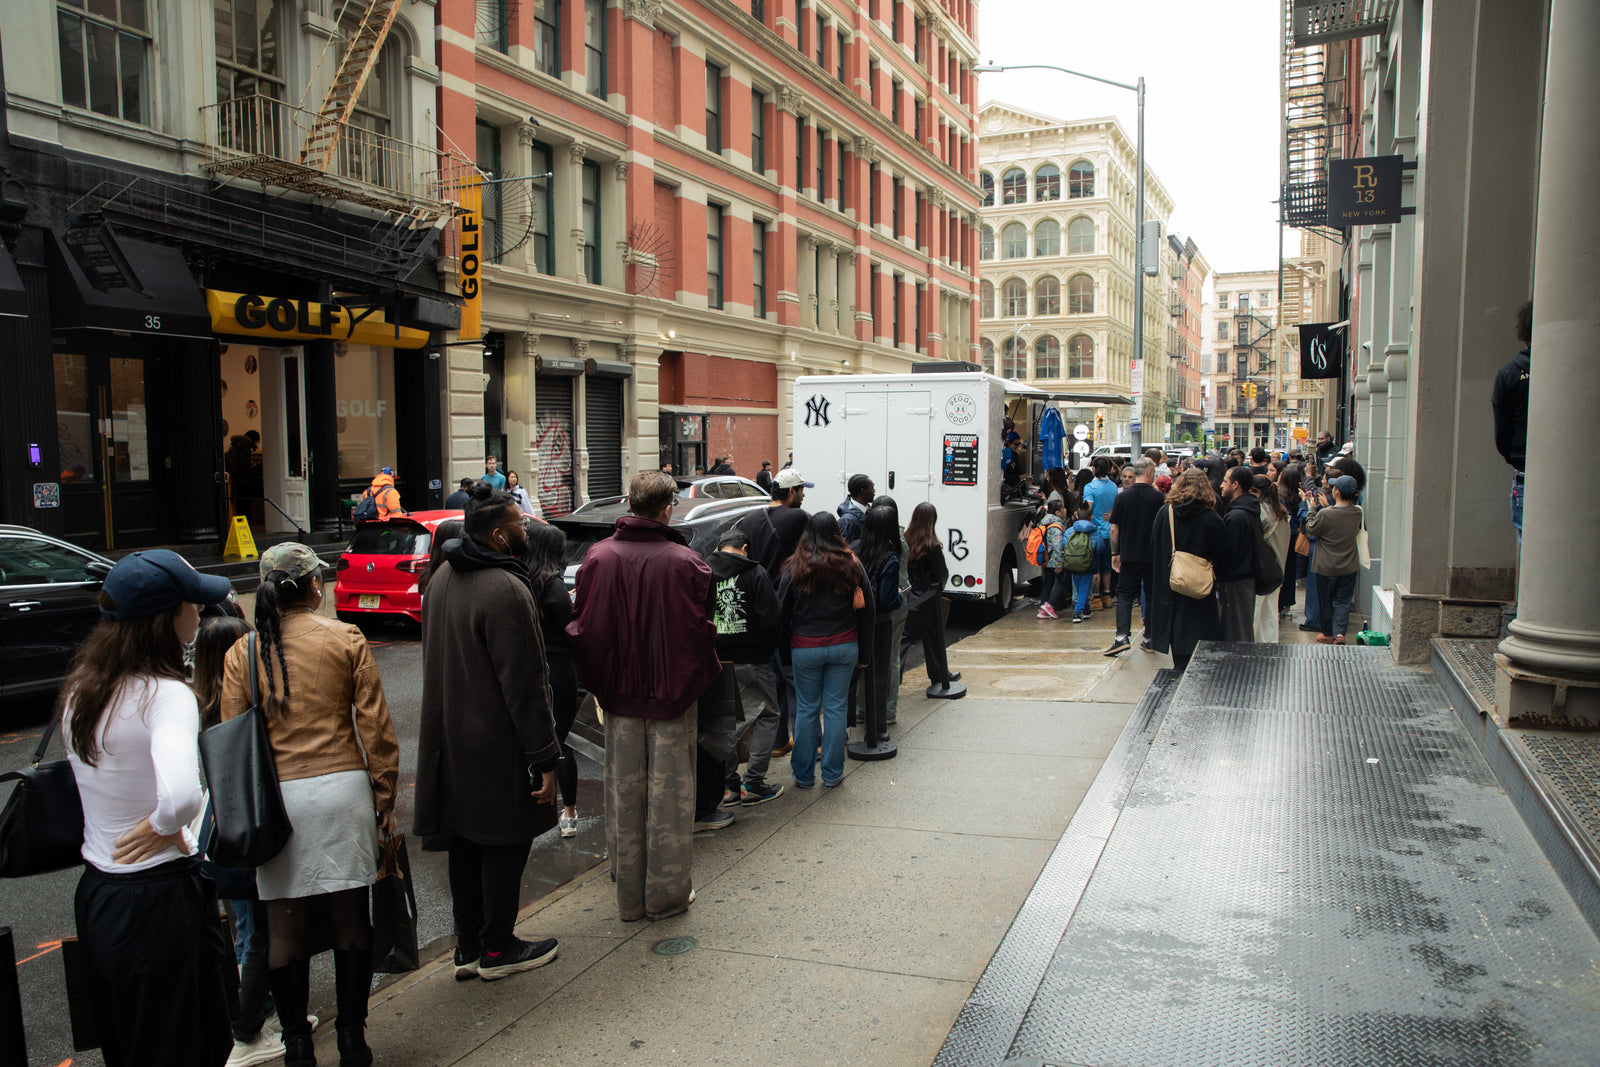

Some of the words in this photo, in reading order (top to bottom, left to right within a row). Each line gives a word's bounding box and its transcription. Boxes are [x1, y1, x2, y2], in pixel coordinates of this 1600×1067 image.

[1353, 165, 1378, 188] R
[1356, 190, 1375, 203] 13
[1342, 210, 1360, 218] NEW
[1364, 209, 1386, 217] YORK
[462, 216, 479, 300] GOLF
[145, 315, 161, 329] 35
[234, 294, 342, 336] GOLF
[949, 395, 973, 406] PEGGY
[336, 400, 387, 418] GOLF
[949, 412, 972, 423] GOODS
[683, 421, 697, 435] 37
